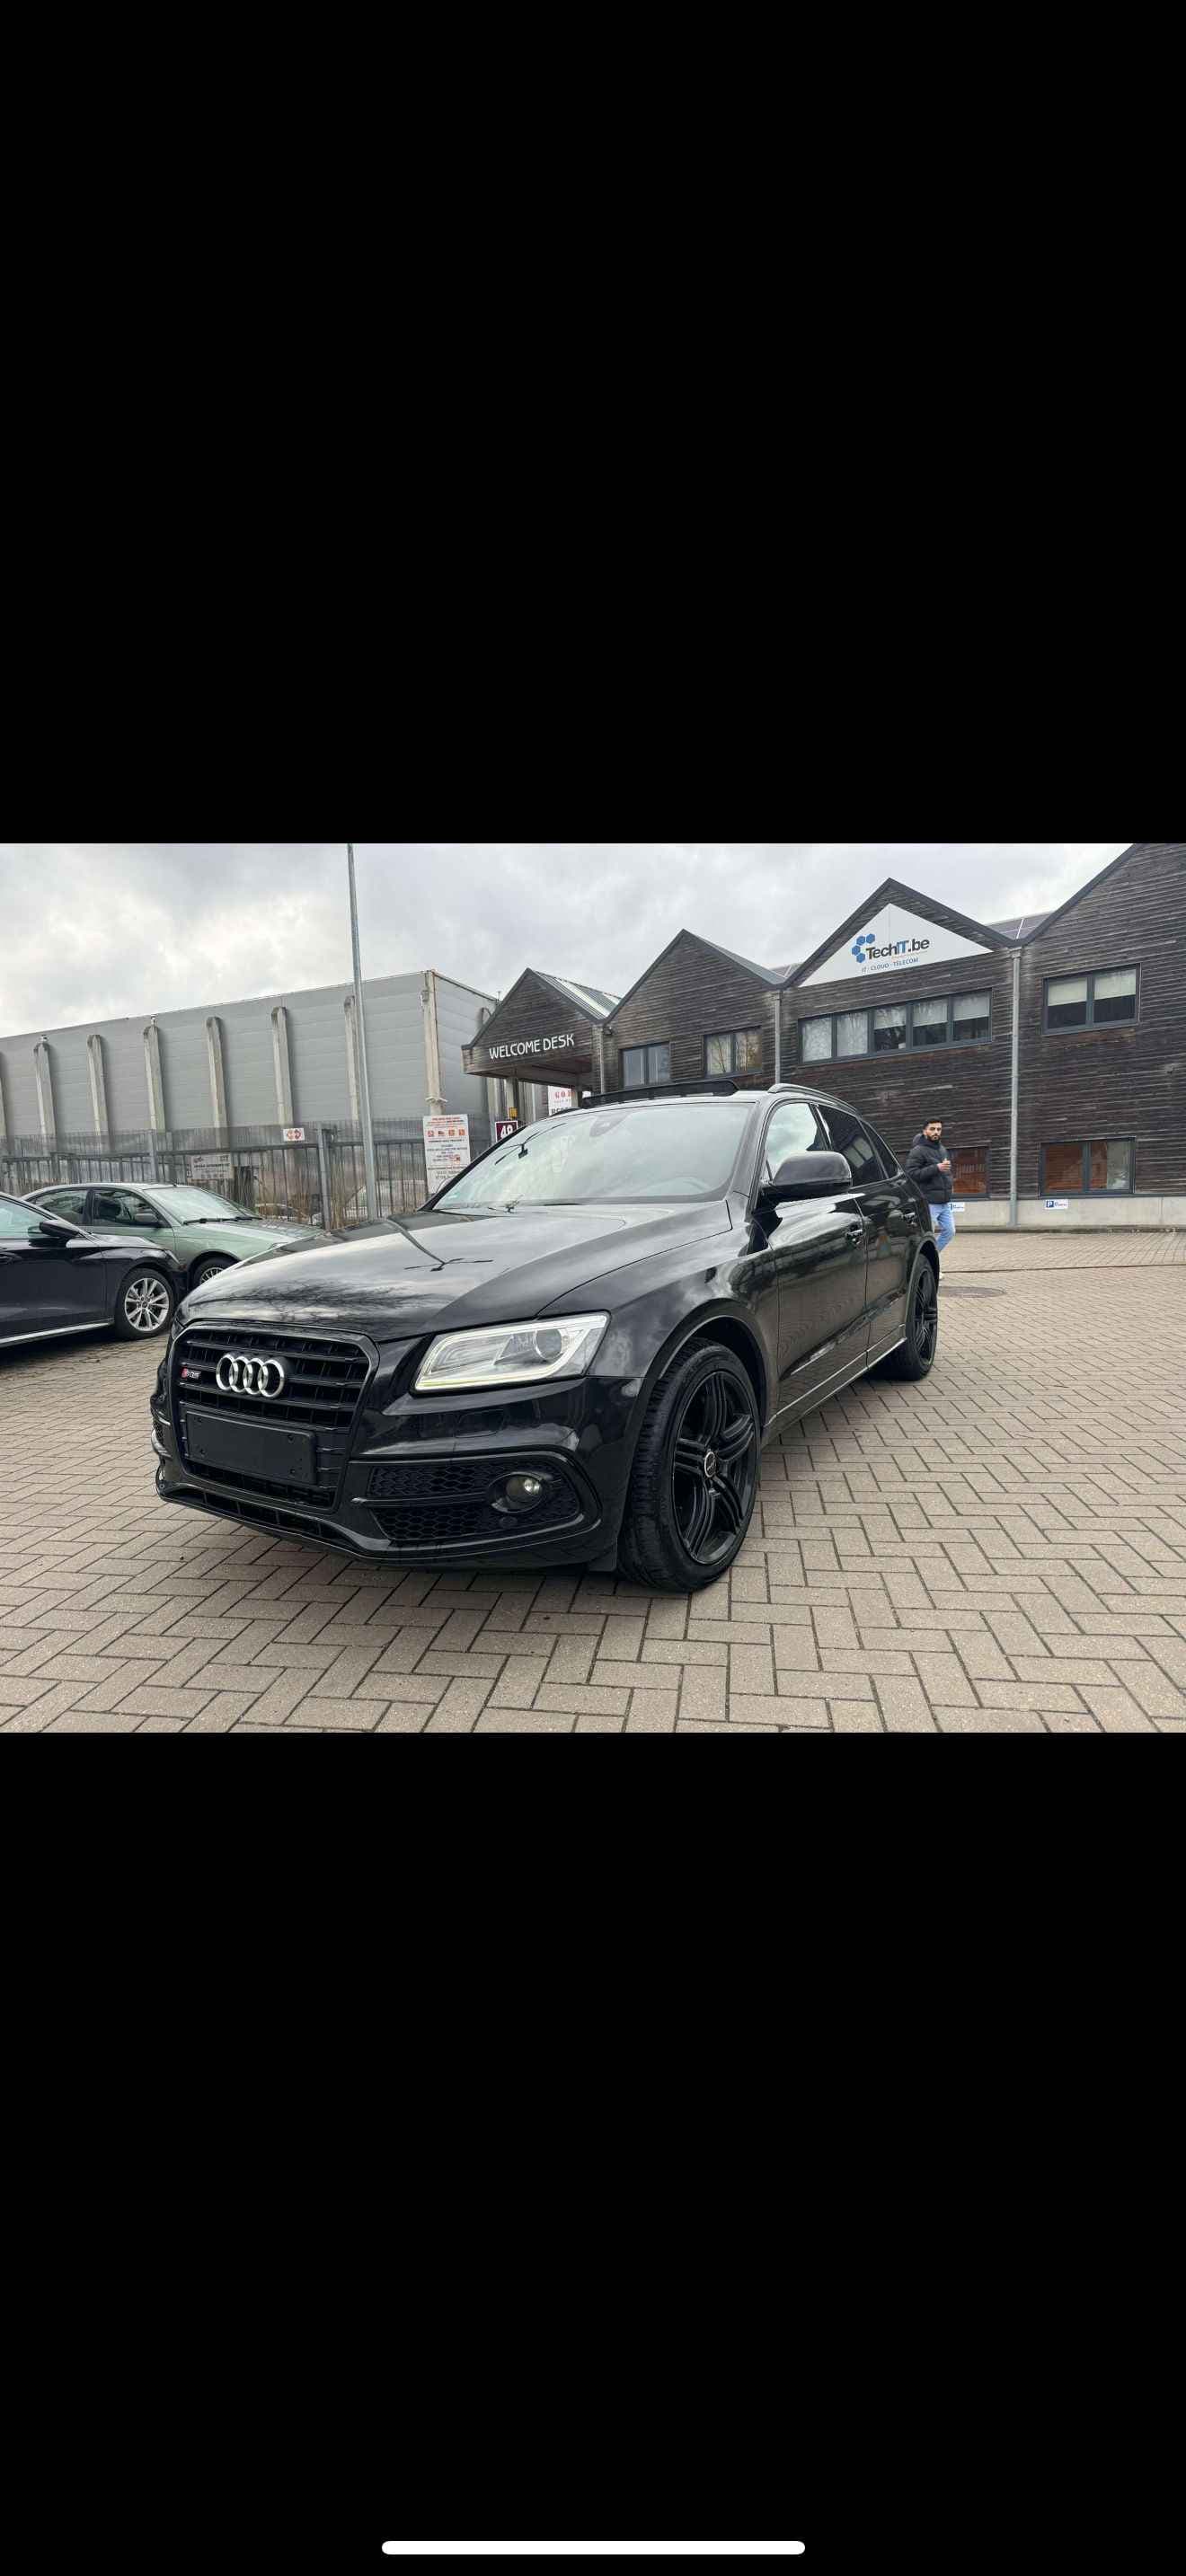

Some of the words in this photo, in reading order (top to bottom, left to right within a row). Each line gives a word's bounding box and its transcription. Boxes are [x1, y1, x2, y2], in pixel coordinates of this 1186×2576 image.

[865, 939, 930, 959] TechIT.be
[871, 963, 890, 971] CLOUD
[893, 957, 919, 966] TELECOM
[489, 1039, 541, 1060] WELCOME
[543, 1033, 575, 1051] DESK
